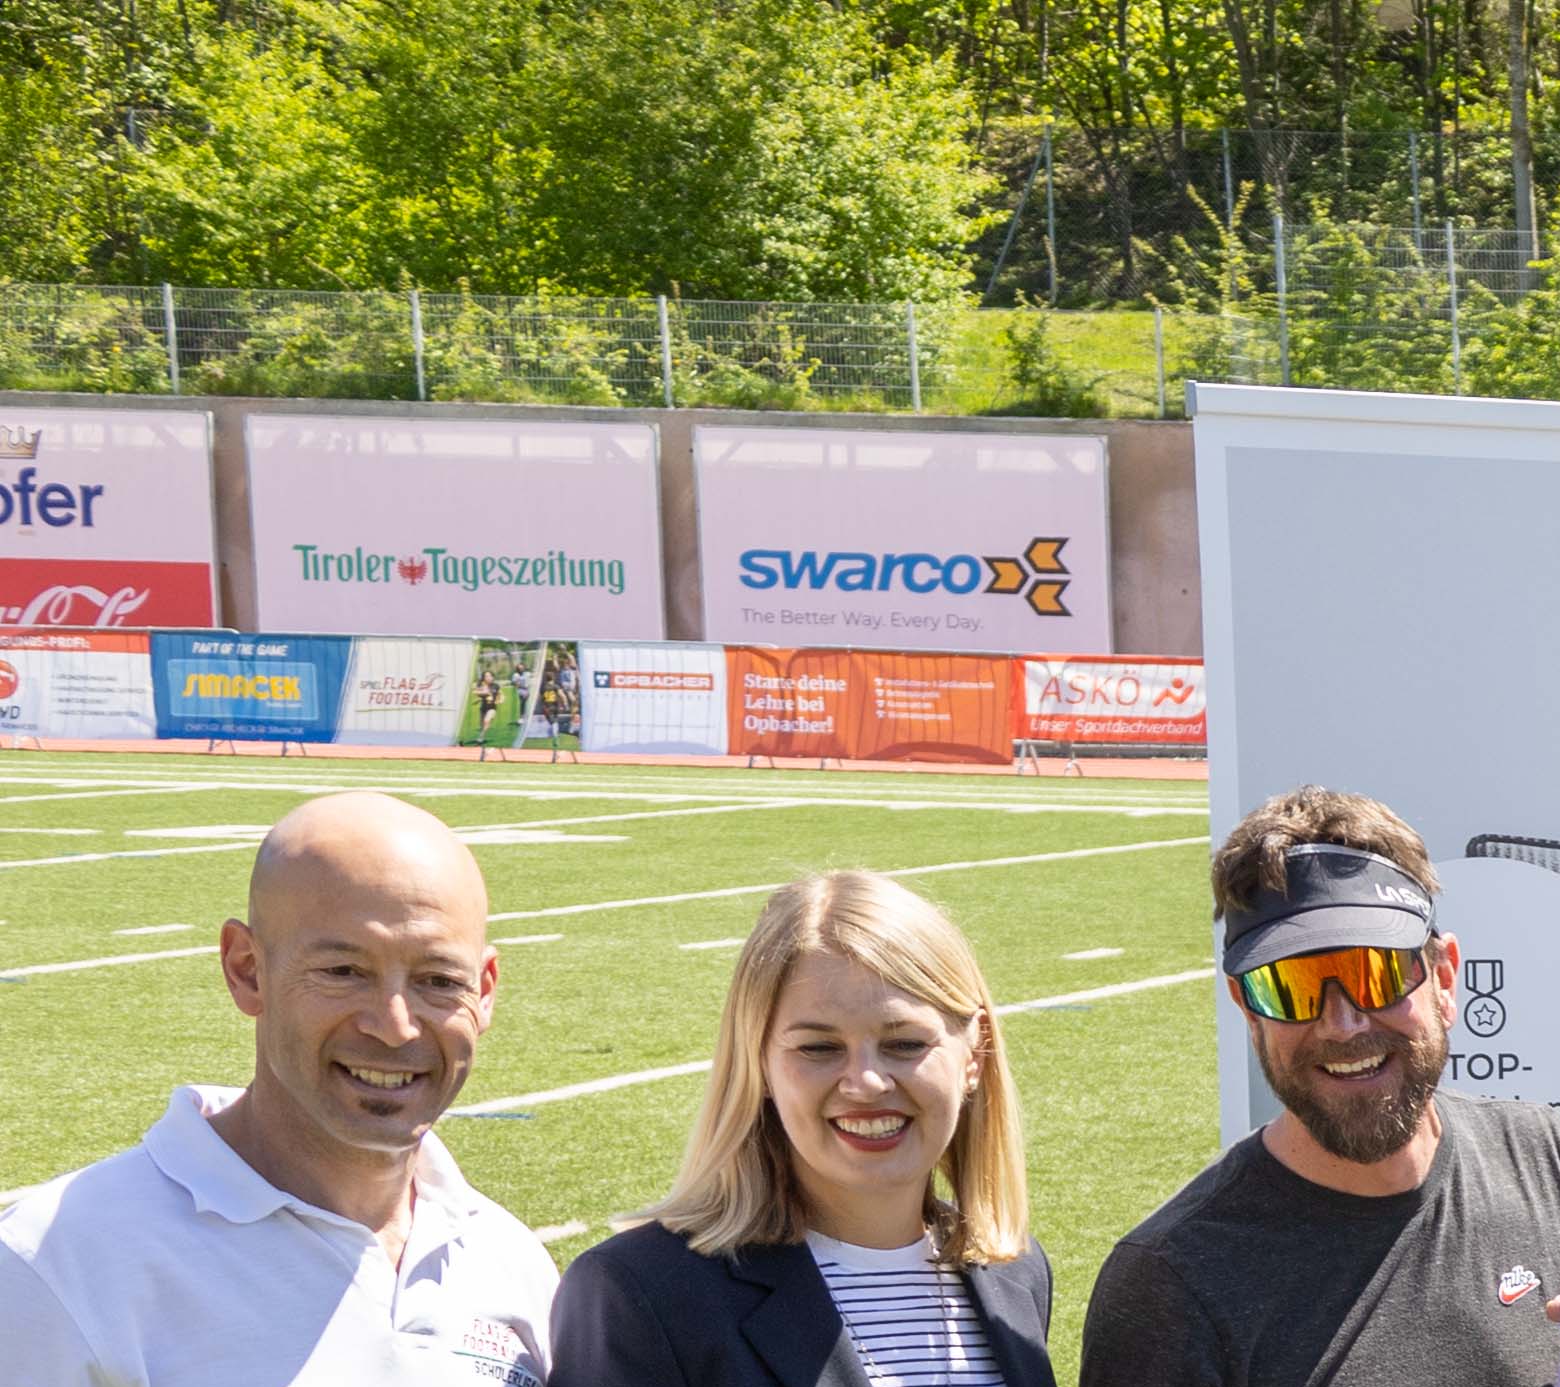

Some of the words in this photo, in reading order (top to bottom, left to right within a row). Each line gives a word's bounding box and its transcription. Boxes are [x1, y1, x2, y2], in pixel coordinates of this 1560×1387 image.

[293, 544, 397, 584] Tiroler
[422, 546, 625, 594] Tageszeitung
[739, 548, 982, 594] swarco
[741, 607, 775, 625] The
[780, 608, 837, 626] Better
[841, 610, 887, 629] Way.
[890, 612, 942, 631] Every
[945, 613, 984, 632] Day.
[192, 641, 220, 654] PART
[221, 642, 234, 655] OF
[236, 643, 253, 656] THE
[256, 644, 288, 656] GAME
[182, 673, 301, 702] SIMACEK
[383, 677, 416, 691] FLAG
[614, 674, 712, 689] OPBACHER
[744, 673, 796, 690] Starte
[798, 675, 847, 691] deine
[1039, 668, 1141, 706] ASKÖ
[368, 692, 434, 707] FOOTBALL
[744, 694, 796, 711] Lehre
[797, 695, 825, 712] bei
[744, 715, 833, 735] Opbacher!
[1030, 716, 1070, 735] Unser
[1075, 716, 1202, 737] Sportdachverband
[1449, 1052, 1533, 1081] TOP-
